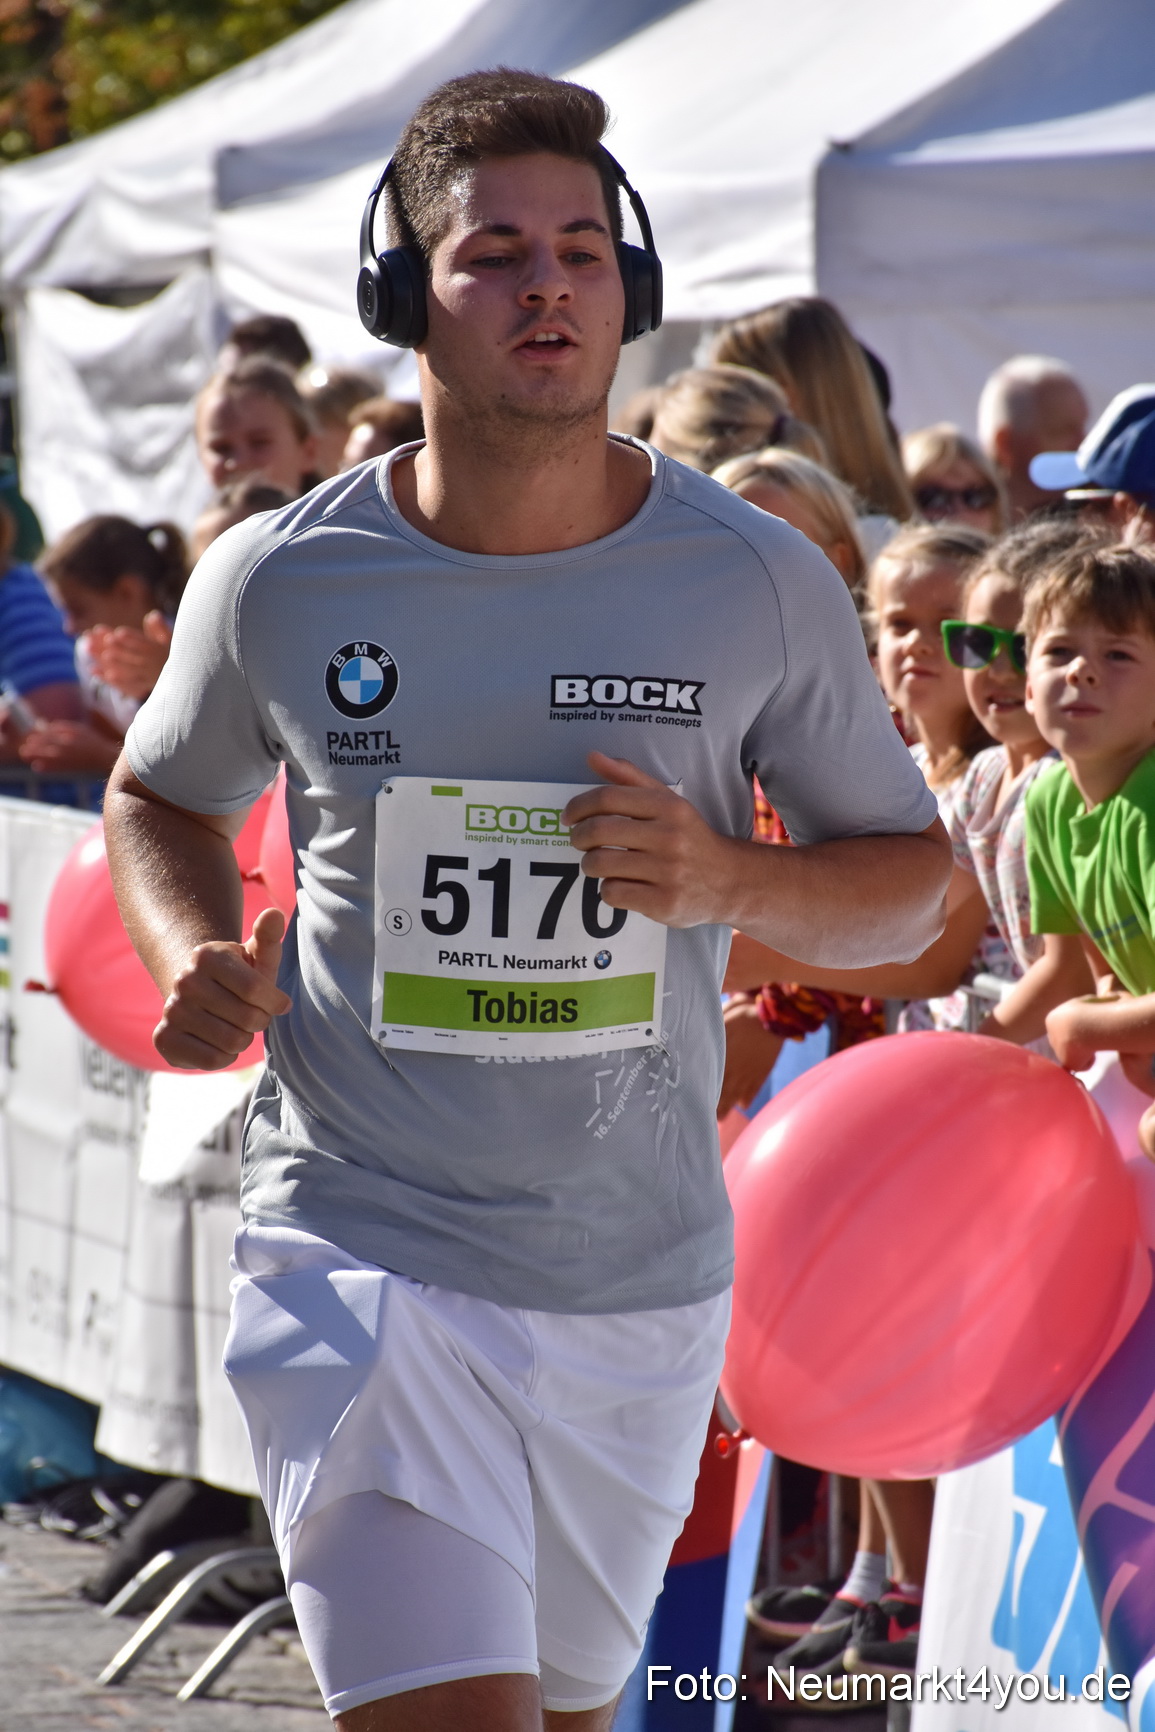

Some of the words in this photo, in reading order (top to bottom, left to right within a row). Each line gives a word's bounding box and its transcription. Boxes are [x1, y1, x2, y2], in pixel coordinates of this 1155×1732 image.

[331, 643, 393, 669] BMW
[551, 675, 706, 715] BOCK
[550, 710, 597, 722] inspired
[600, 711, 615, 722] by
[618, 712, 653, 723] smart
[655, 715, 702, 728] concepts
[326, 730, 401, 751] PARTL
[328, 750, 402, 766] Neumarkt
[465, 832, 503, 843] inspired
[506, 834, 518, 845] by
[520, 837, 549, 846] smart
[421, 854, 628, 940] 5176
[438, 950, 498, 968] PARTL
[503, 954, 588, 970] Neumarkt
[466, 989, 579, 1025] Tobias
[593, 1123, 612, 1140] 16.
[607, 1055, 648, 1123] September
